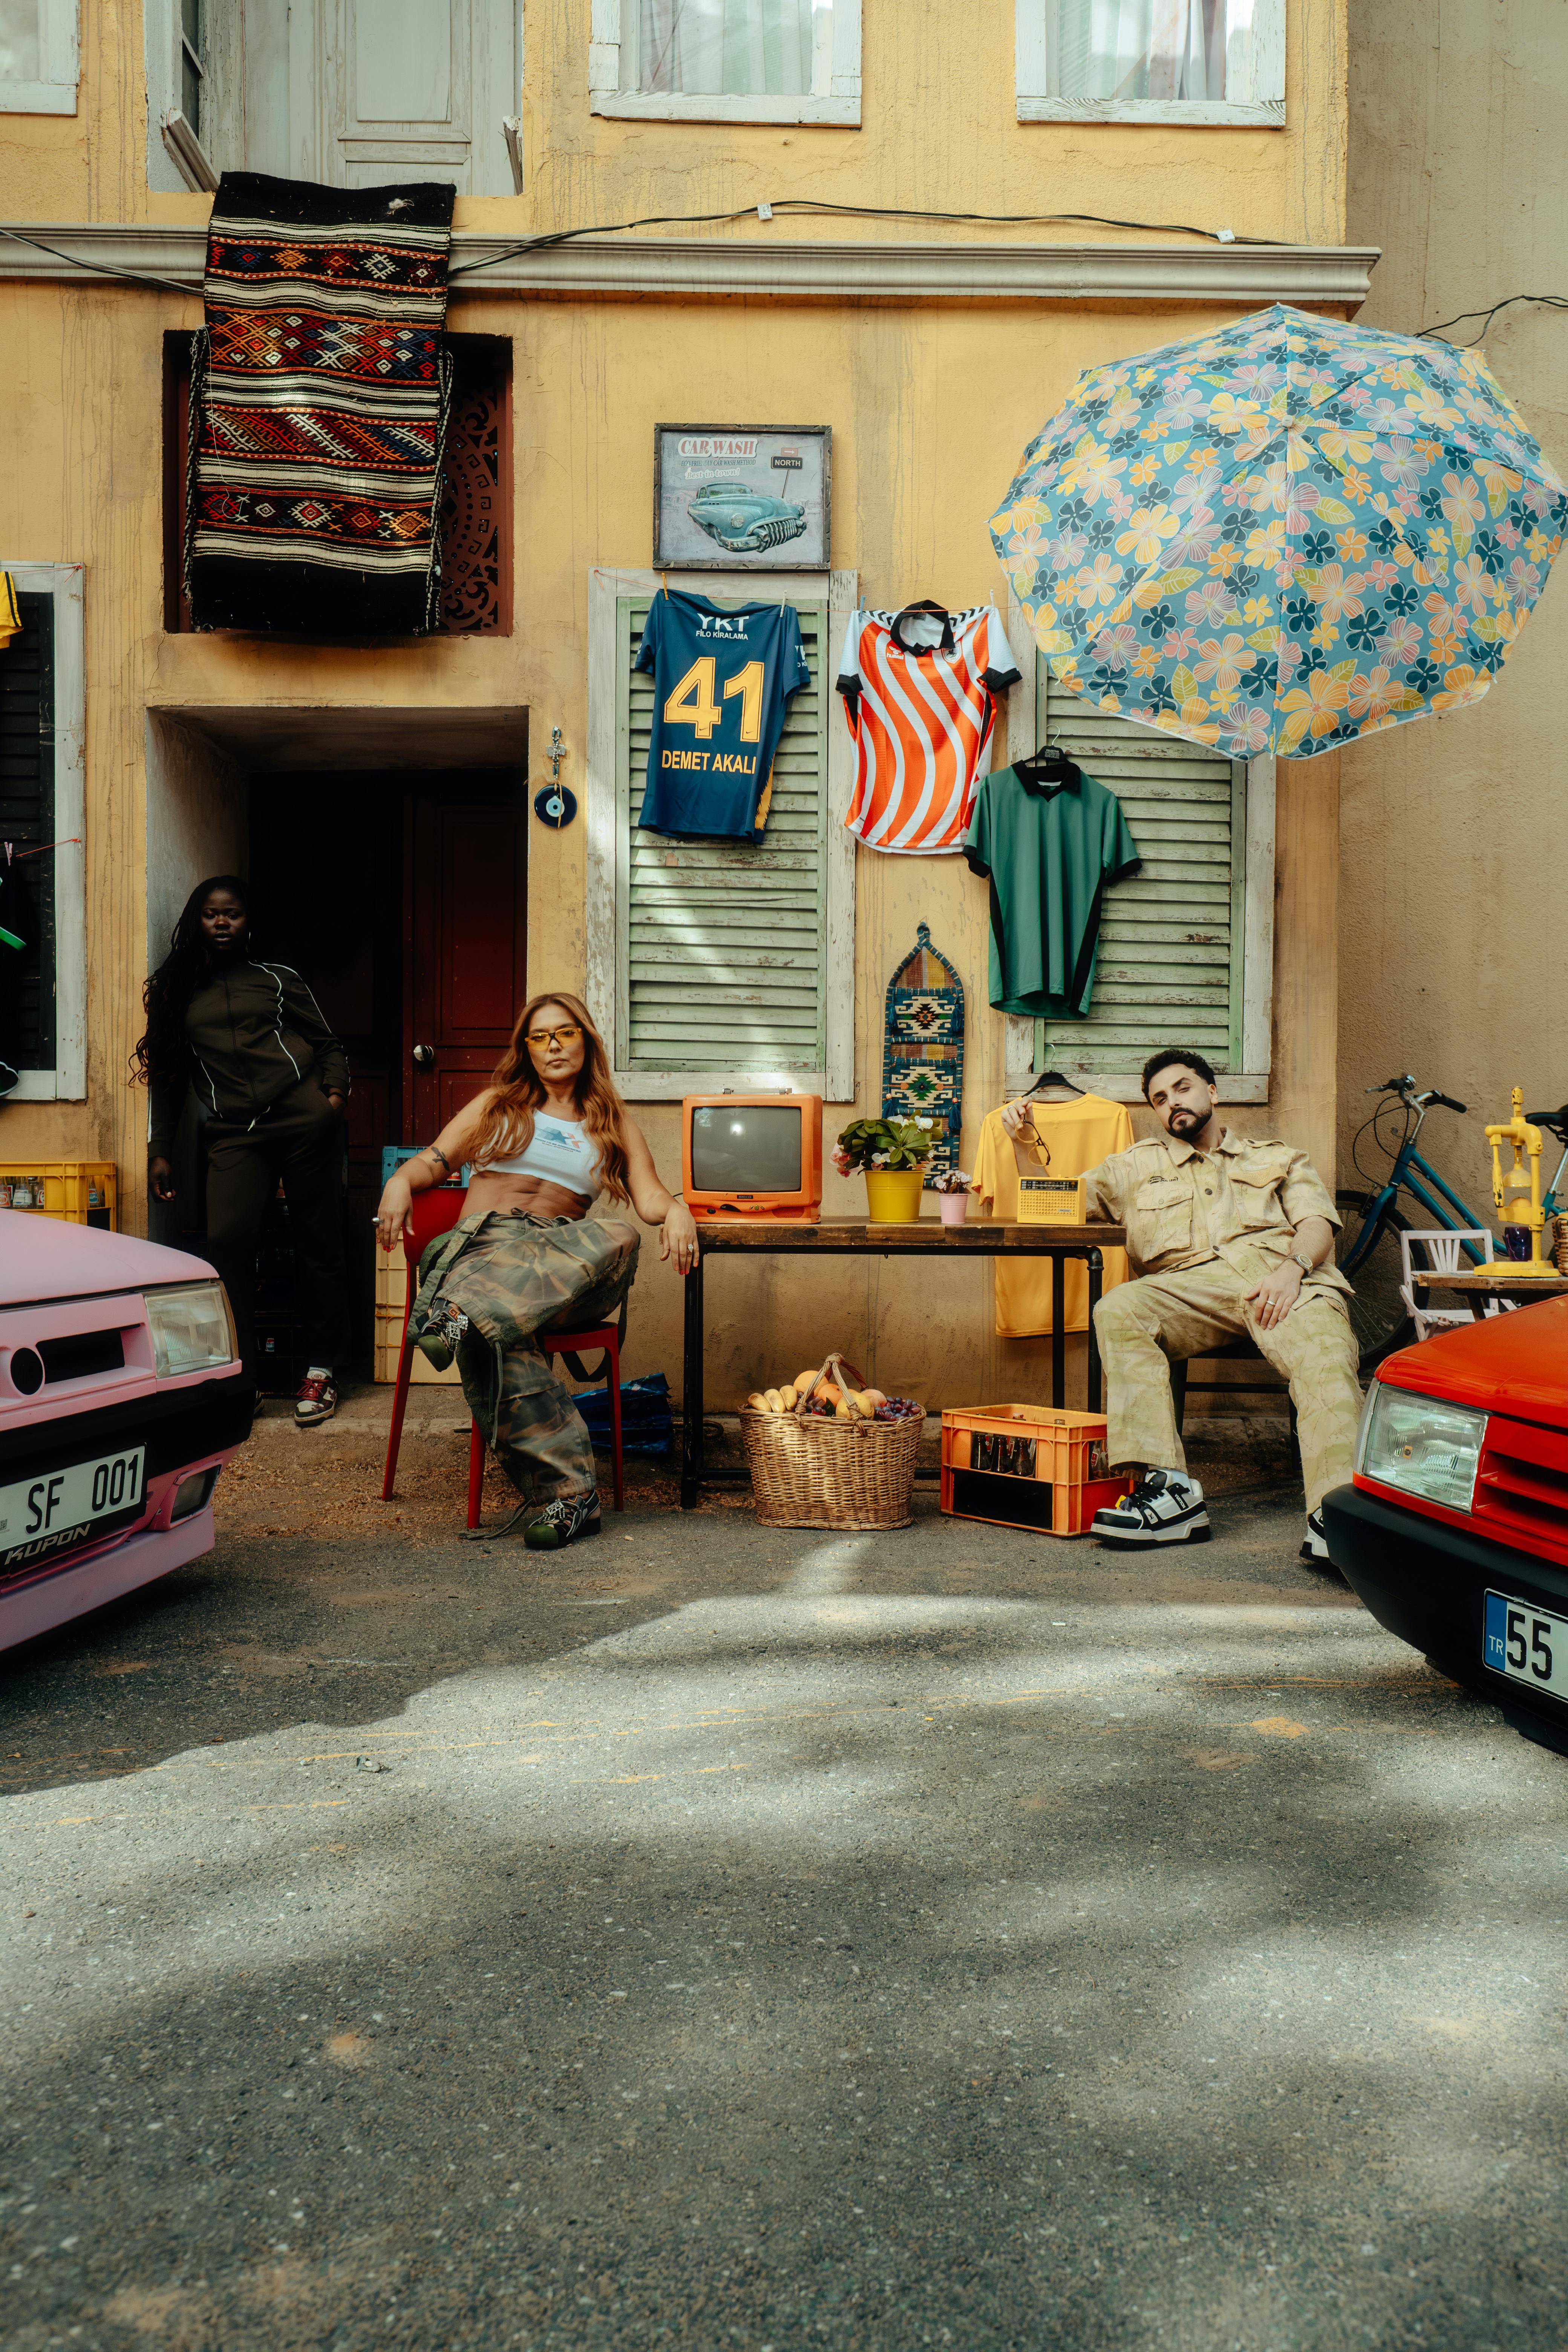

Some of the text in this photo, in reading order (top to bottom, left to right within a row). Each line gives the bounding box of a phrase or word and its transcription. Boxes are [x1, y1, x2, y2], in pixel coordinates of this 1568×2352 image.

[681, 440, 755, 455] CAR WASH
[716, 468, 740, 476] town!
[697, 612, 749, 632] YKT
[664, 657, 764, 743] 41
[662, 750, 710, 771] DEMET
[26, 1454, 138, 1533] SF 001
[1174, 1493, 1186, 1508] VUITTON
[1489, 1635, 1504, 1655] TR
[1507, 1609, 1552, 1681] 55
